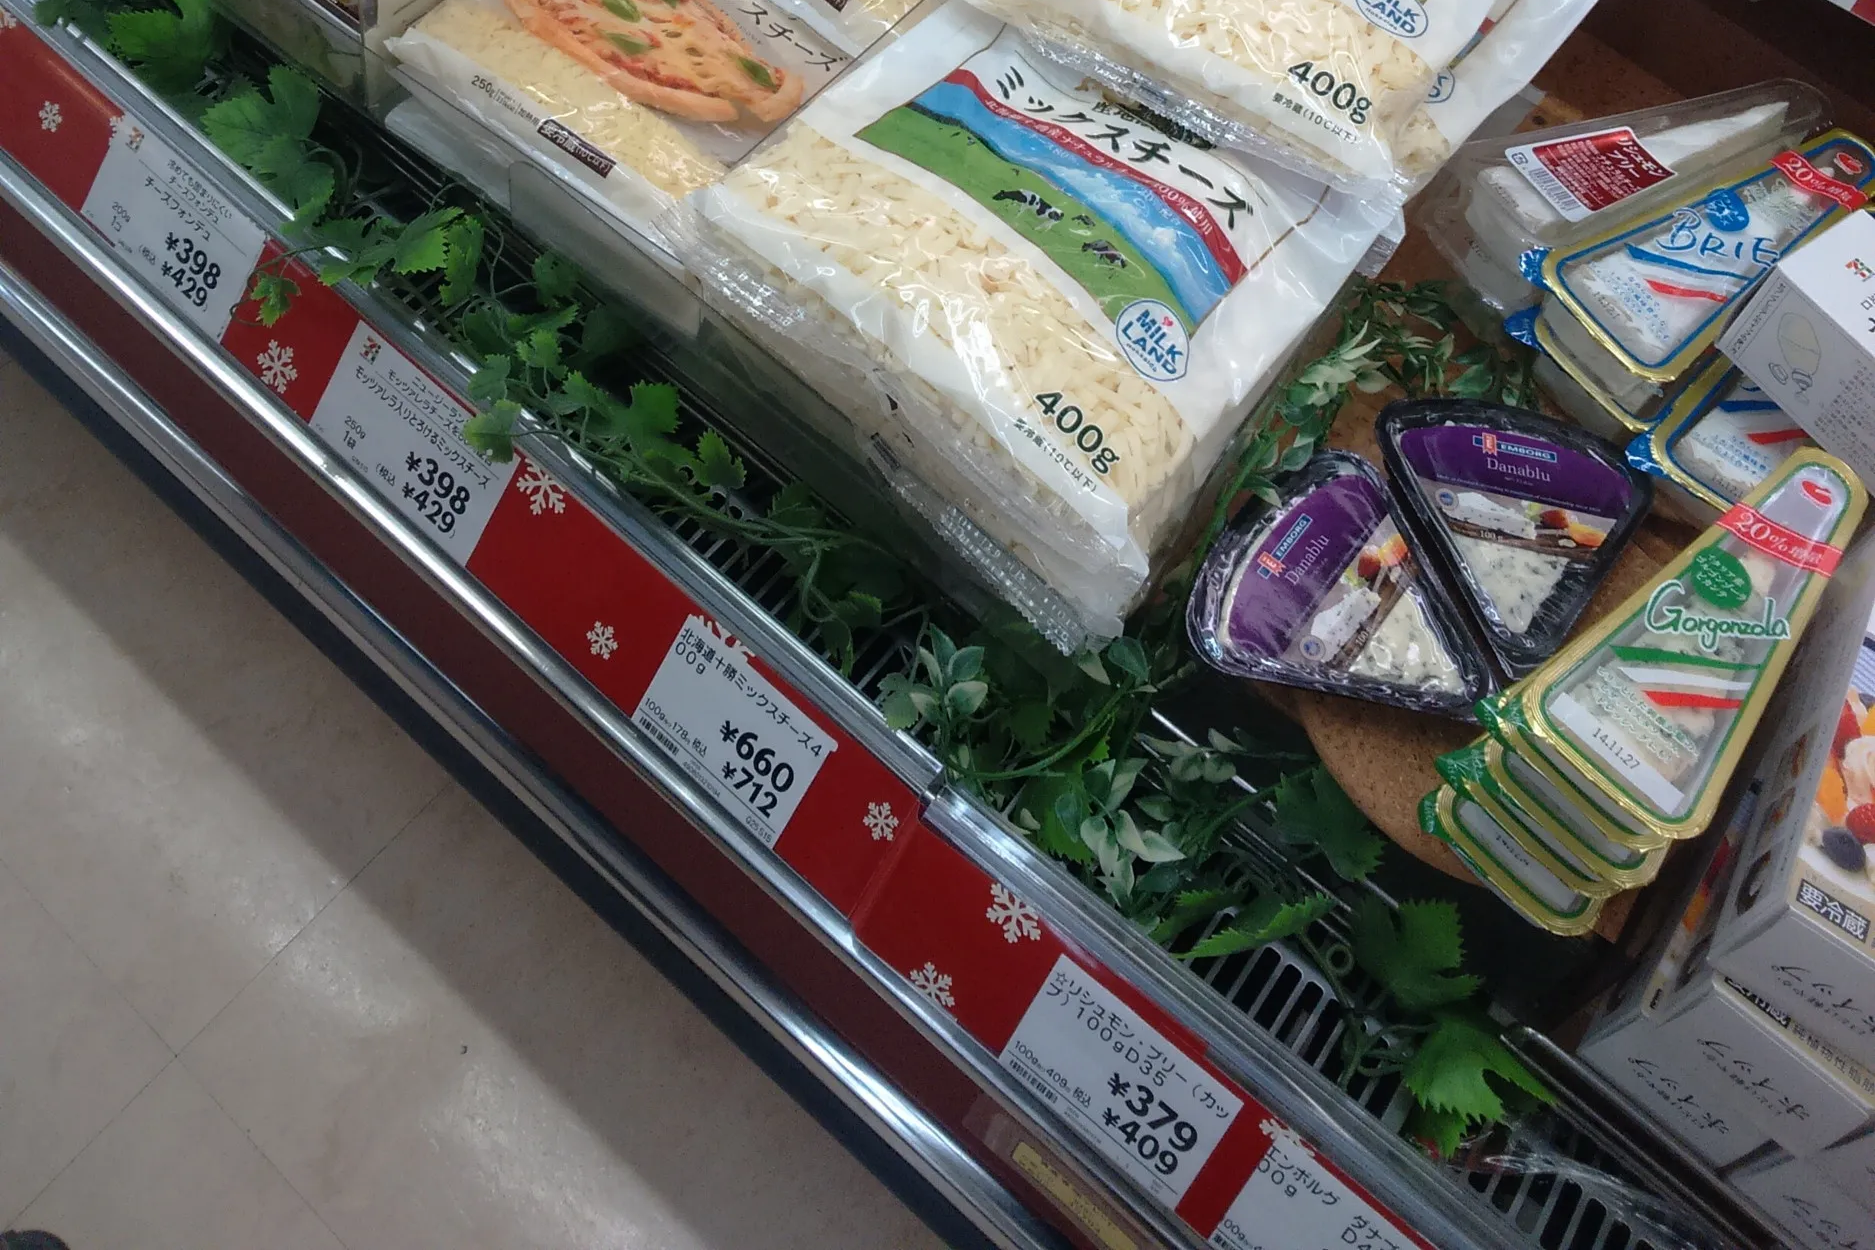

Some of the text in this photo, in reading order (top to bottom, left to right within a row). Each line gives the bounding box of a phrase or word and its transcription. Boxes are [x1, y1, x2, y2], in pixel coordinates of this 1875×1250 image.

[471, 75, 495, 97] 250g
[1287, 61, 1372, 125] 400g
[995, 65, 1254, 231] ミックスチーズ
[111, 202, 131, 223] 200g
[145, 176, 211, 242] チーズフォンデュ
[166, 160, 232, 219] 冷めても固まりにくい
[169, 176, 219, 224] チーズフォンデュ
[166, 232, 221, 290] ¥398
[1656, 207, 1780, 267] BRIE
[1121, 320, 1178, 375] LAND
[1135, 309, 1184, 364] MILK
[344, 415, 367, 440] 250g
[355, 365, 492, 490] モッツァレラ入りとろけるミックスチーズ
[1035, 391, 1120, 475] 400g
[1500, 442, 1552, 461] EMBORG
[405, 450, 471, 515] ¥398
[1487, 456, 1551, 482] Danablu
[1275, 516, 1309, 558] EMBORG
[1285, 534, 1331, 586] Danablu
[1646, 580, 1791, 650] Gorgonzola
[675, 641, 706, 675] 00g
[680, 628, 823, 757] 北海道十勝ミックスチーズ4
[719, 720, 795, 794] ¥660
[1592, 727, 1640, 770] 14.11.27
[721, 761, 778, 819] ¥712
[1802, 883, 1865, 940] 要冷蔵
[1072, 1087, 1092, 1107] 税込
[1108, 1073, 1199, 1152] ¥379
[1102, 1108, 1179, 1176] ¥409
[1258, 1159, 1297, 1198] 00g
[1267, 1146, 1340, 1206] エンボルグ
